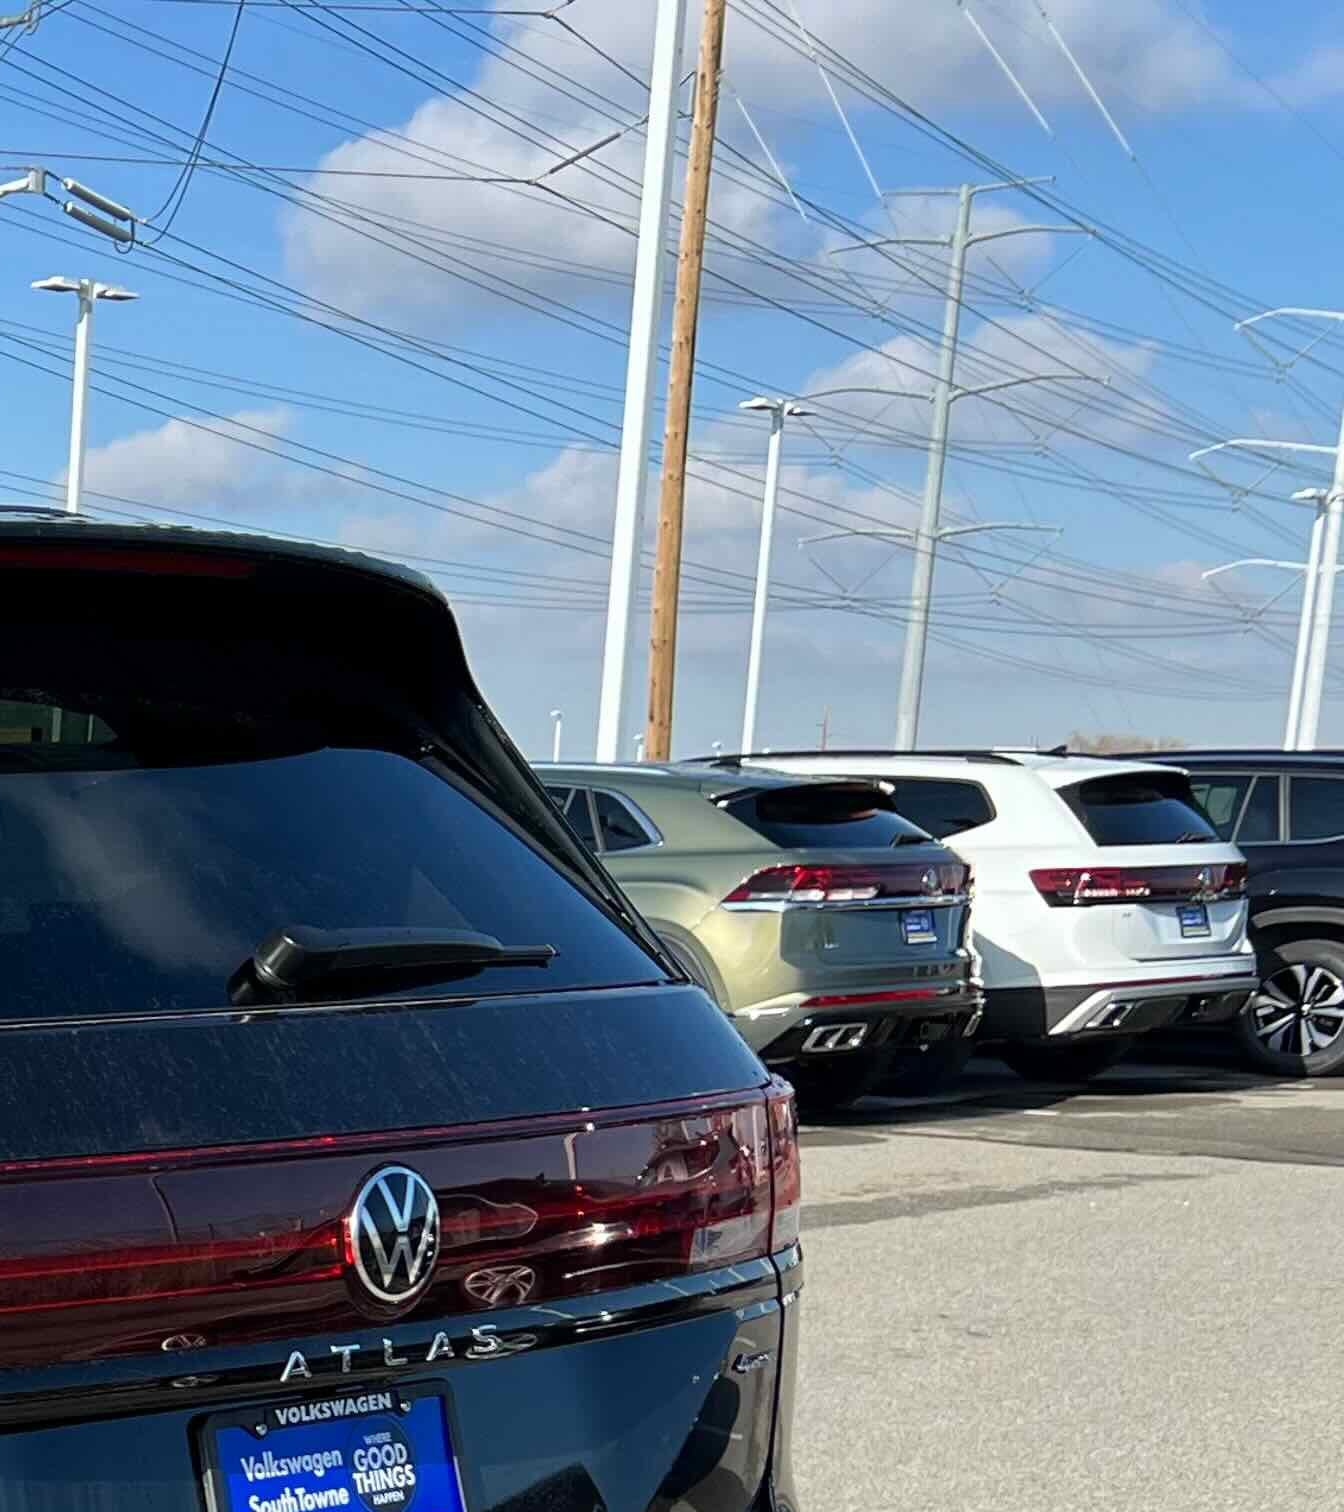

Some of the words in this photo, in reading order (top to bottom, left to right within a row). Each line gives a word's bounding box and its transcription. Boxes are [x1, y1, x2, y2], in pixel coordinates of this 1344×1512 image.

[279, 1324, 502, 1383] ATLAS
[275, 1392, 393, 1425] VOLKSWAGEN
[240, 1449, 344, 1483] Volkswagen
[353, 1443, 408, 1472] GOOD
[352, 1464, 416, 1495] THINGS
[372, 1489, 406, 1506] HAPPEN
